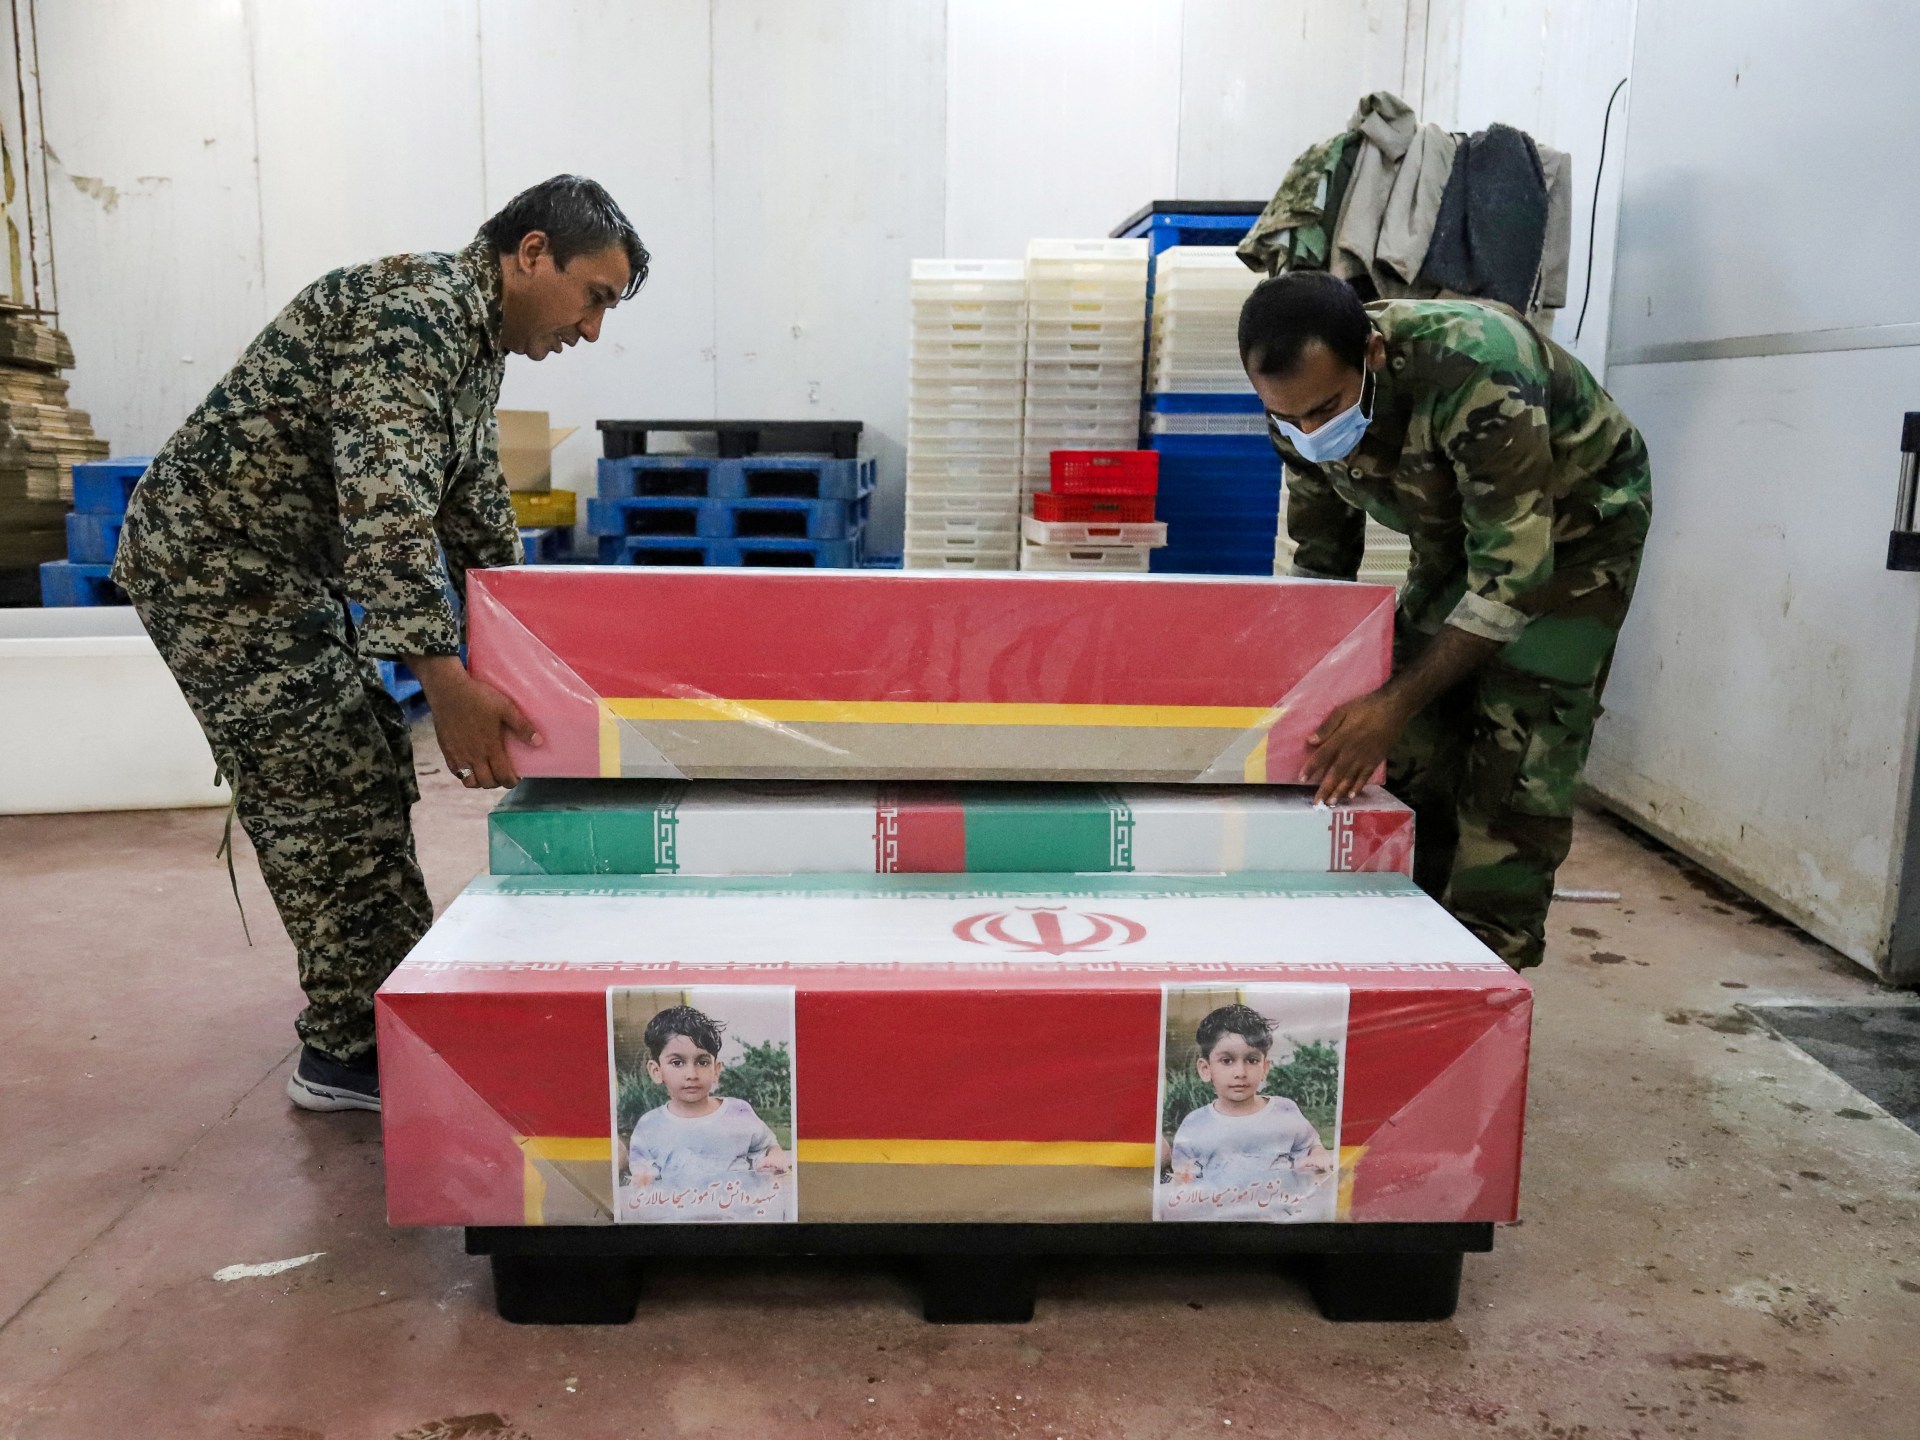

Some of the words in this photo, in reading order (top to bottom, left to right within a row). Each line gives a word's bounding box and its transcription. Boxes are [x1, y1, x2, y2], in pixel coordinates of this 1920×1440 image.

[628, 1190, 670, 1210] سالاری
[690, 1182, 721, 1205] آموز
[718, 1180, 751, 1209] دانش
[752, 1181, 780, 1215] شهید
[1168, 1189, 1210, 1208] سالاری
[1229, 1182, 1260, 1204] آموز
[1257, 1180, 1290, 1208] دانش
